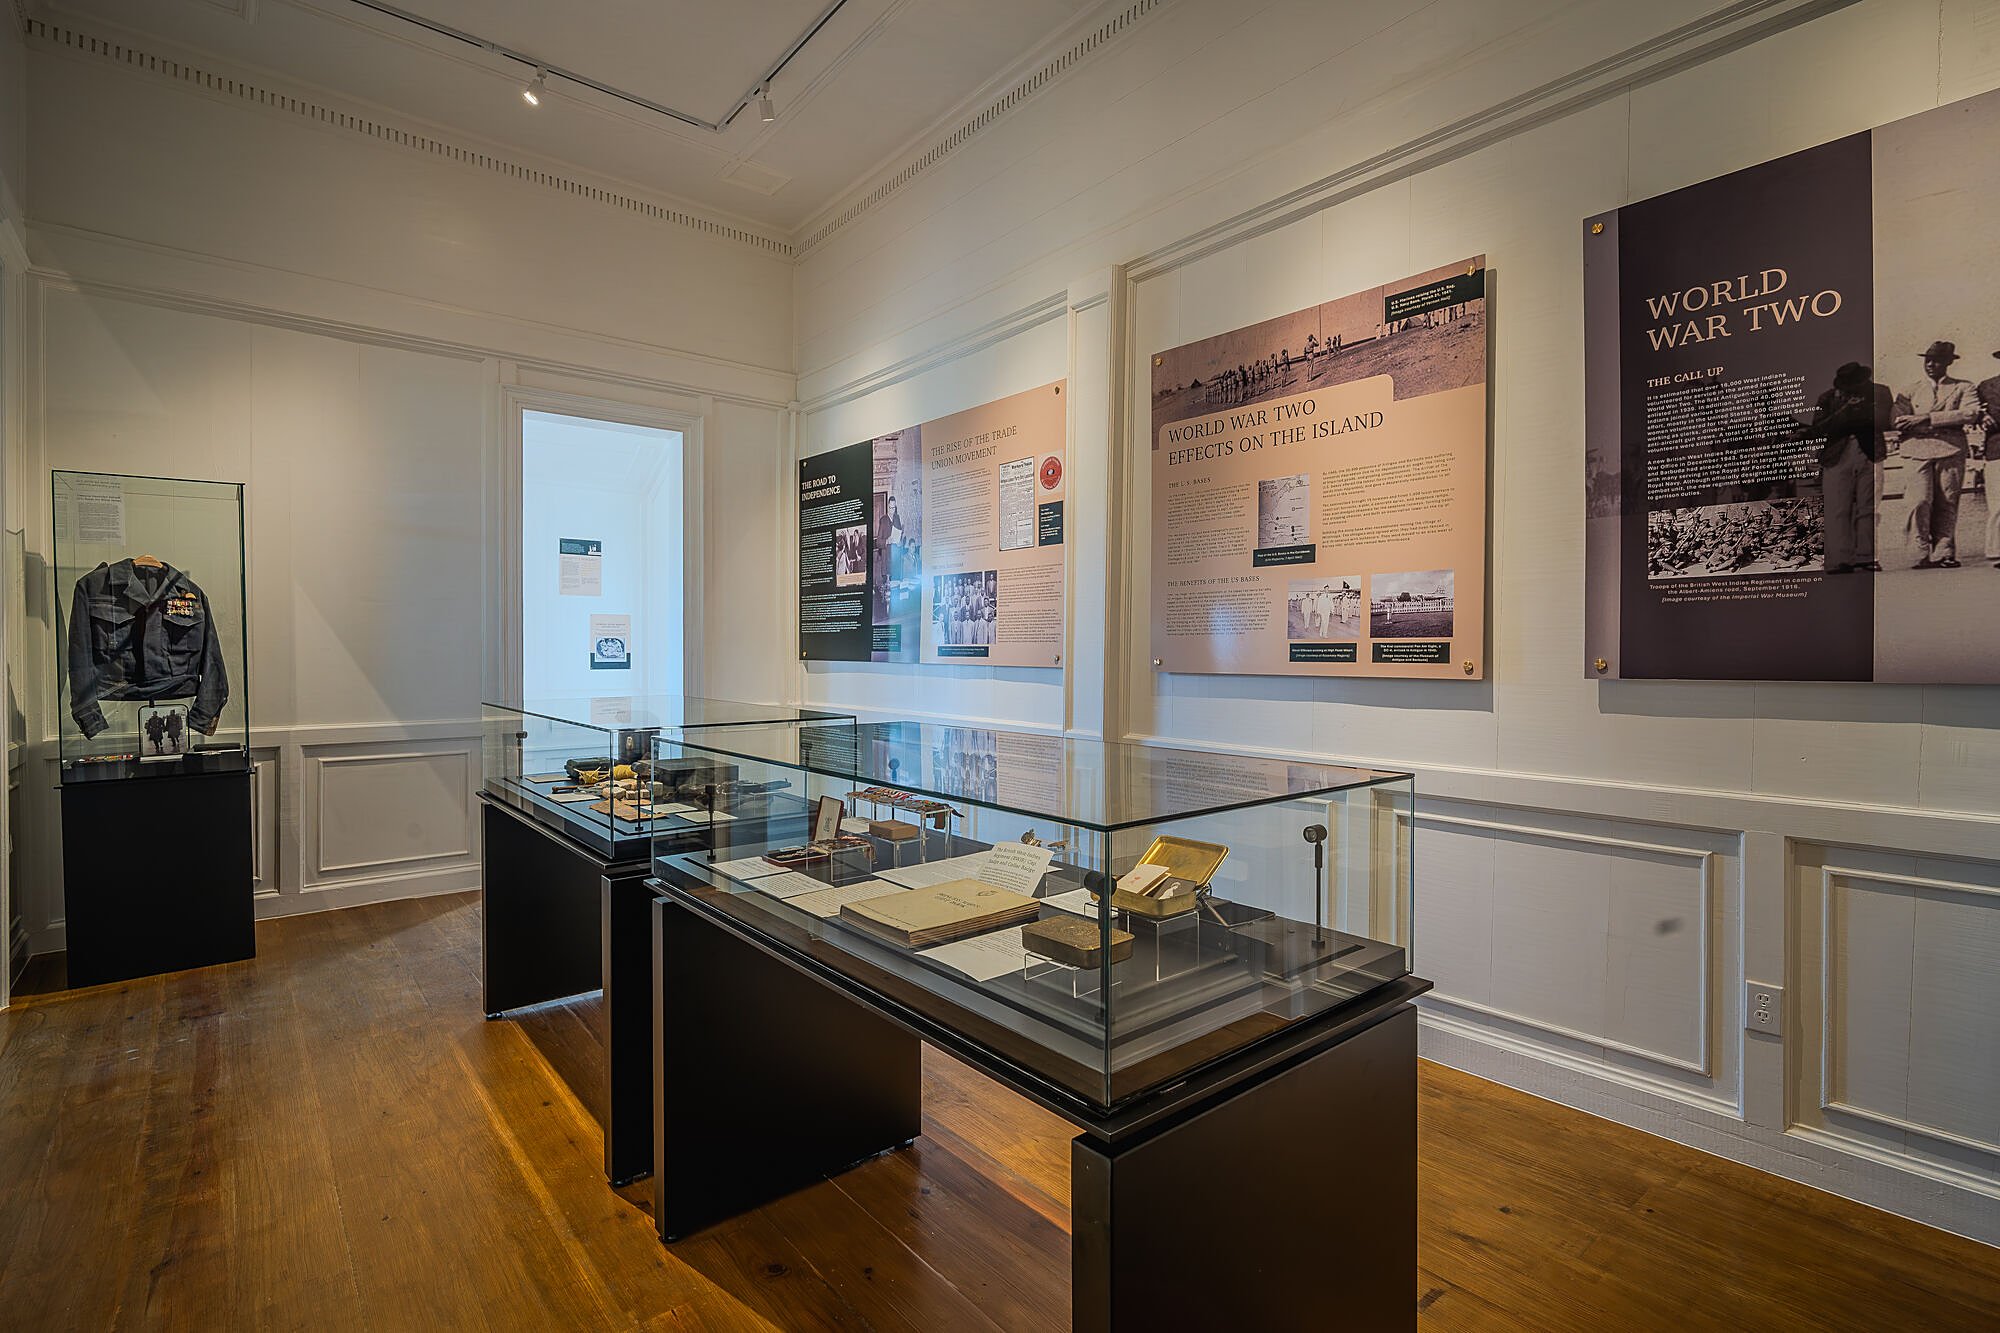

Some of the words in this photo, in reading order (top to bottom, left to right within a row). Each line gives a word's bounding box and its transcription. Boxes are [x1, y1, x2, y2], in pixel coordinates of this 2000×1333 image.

[1647, 268, 1787, 319] WORLD
[1647, 314, 1730, 351] WAR
[1744, 290, 1842, 331] TWO
[1647, 377, 1670, 387] THE
[1674, 371, 1703, 382] CALL
[1707, 367, 1723, 376] UP
[1169, 420, 1224, 443] WORLD
[1230, 410, 1267, 430] WAR
[1273, 399, 1316, 422] TWO
[931, 446, 944, 456] THE
[947, 441, 961, 453] RISE
[963, 438, 973, 448] OF
[975, 433, 990, 445] THE
[992, 426, 1017, 440] TRADE
[1169, 441, 1233, 465] EFFECTS
[1240, 435, 1264, 452] ON
[1270, 426, 1306, 447] THE
[1313, 411, 1384, 438] ISLAND
[932, 456, 953, 470] UNION
[956, 446, 997, 464] MOVEMENT
[802, 481, 812, 490] THE
[813, 478, 827, 488] ROAD
[828, 475, 836, 484] TO
[802, 486, 840, 501] INDEPENDENCE
